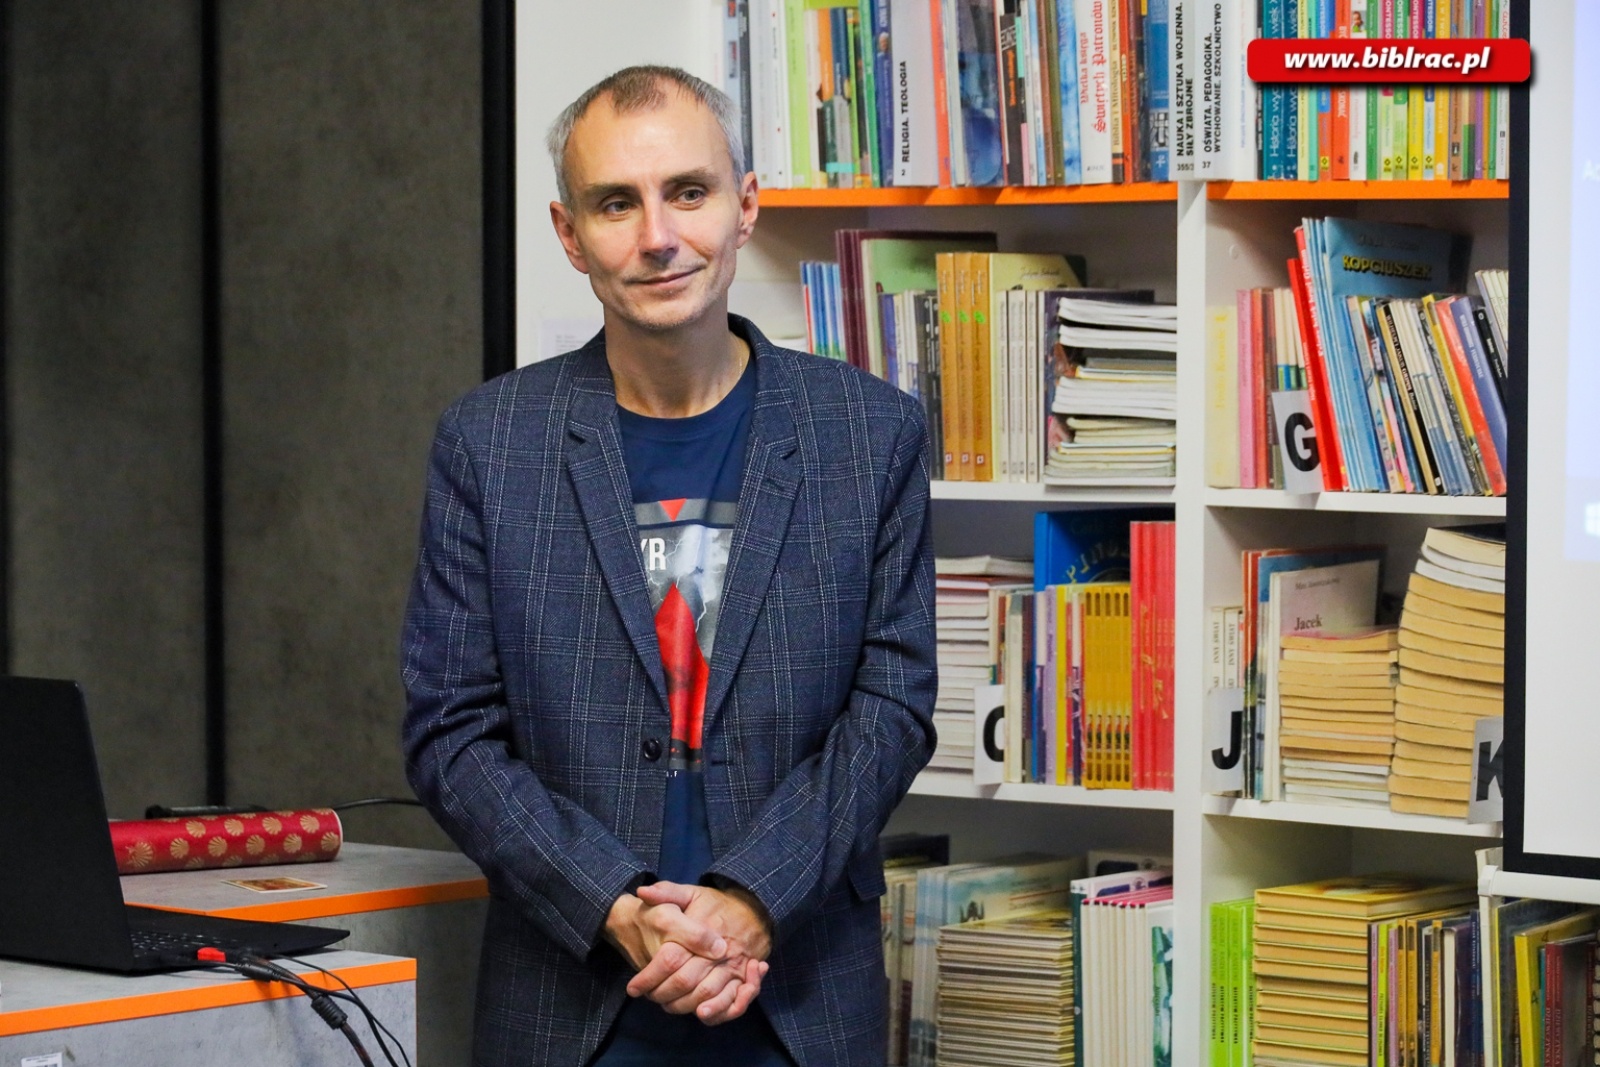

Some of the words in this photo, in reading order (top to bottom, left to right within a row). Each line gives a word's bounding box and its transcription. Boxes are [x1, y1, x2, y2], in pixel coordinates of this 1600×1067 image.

[1090, 1, 1107, 66] Patronów
[1175, 3, 1183, 60] WOJENNA.
[1213, 4, 1222, 77] SZKOLNICTWO
[900, 61, 909, 113] TEOLOGIA
[1110, 61, 1120, 107] Mitologia
[1176, 64, 1184, 108] SZTUKA
[1204, 33, 1212, 102] PEDAGOGIKA.
[1091, 72, 1108, 133] Świętych
[1185, 79, 1194, 130] ZBROJNE
[1213, 81, 1222, 153] WYCHOWANIE.
[901, 118, 910, 162] RELIGIA.
[1111, 118, 1120, 146] Biblia
[1176, 118, 1184, 157] NAUKA
[1186, 134, 1194, 157] SIŁY
[1203, 105, 1212, 153] OŚWIATA.
[1269, 115, 1279, 157] Historia
[1286, 115, 1297, 157] Historia
[1202, 161, 1211, 170] 37
[1342, 254, 1433, 281] KOPCIUSZEK
[1284, 411, 1321, 472] G
[1294, 614, 1322, 631] Jacek
[1211, 710, 1243, 770] J
[1476, 741, 1503, 802] K
